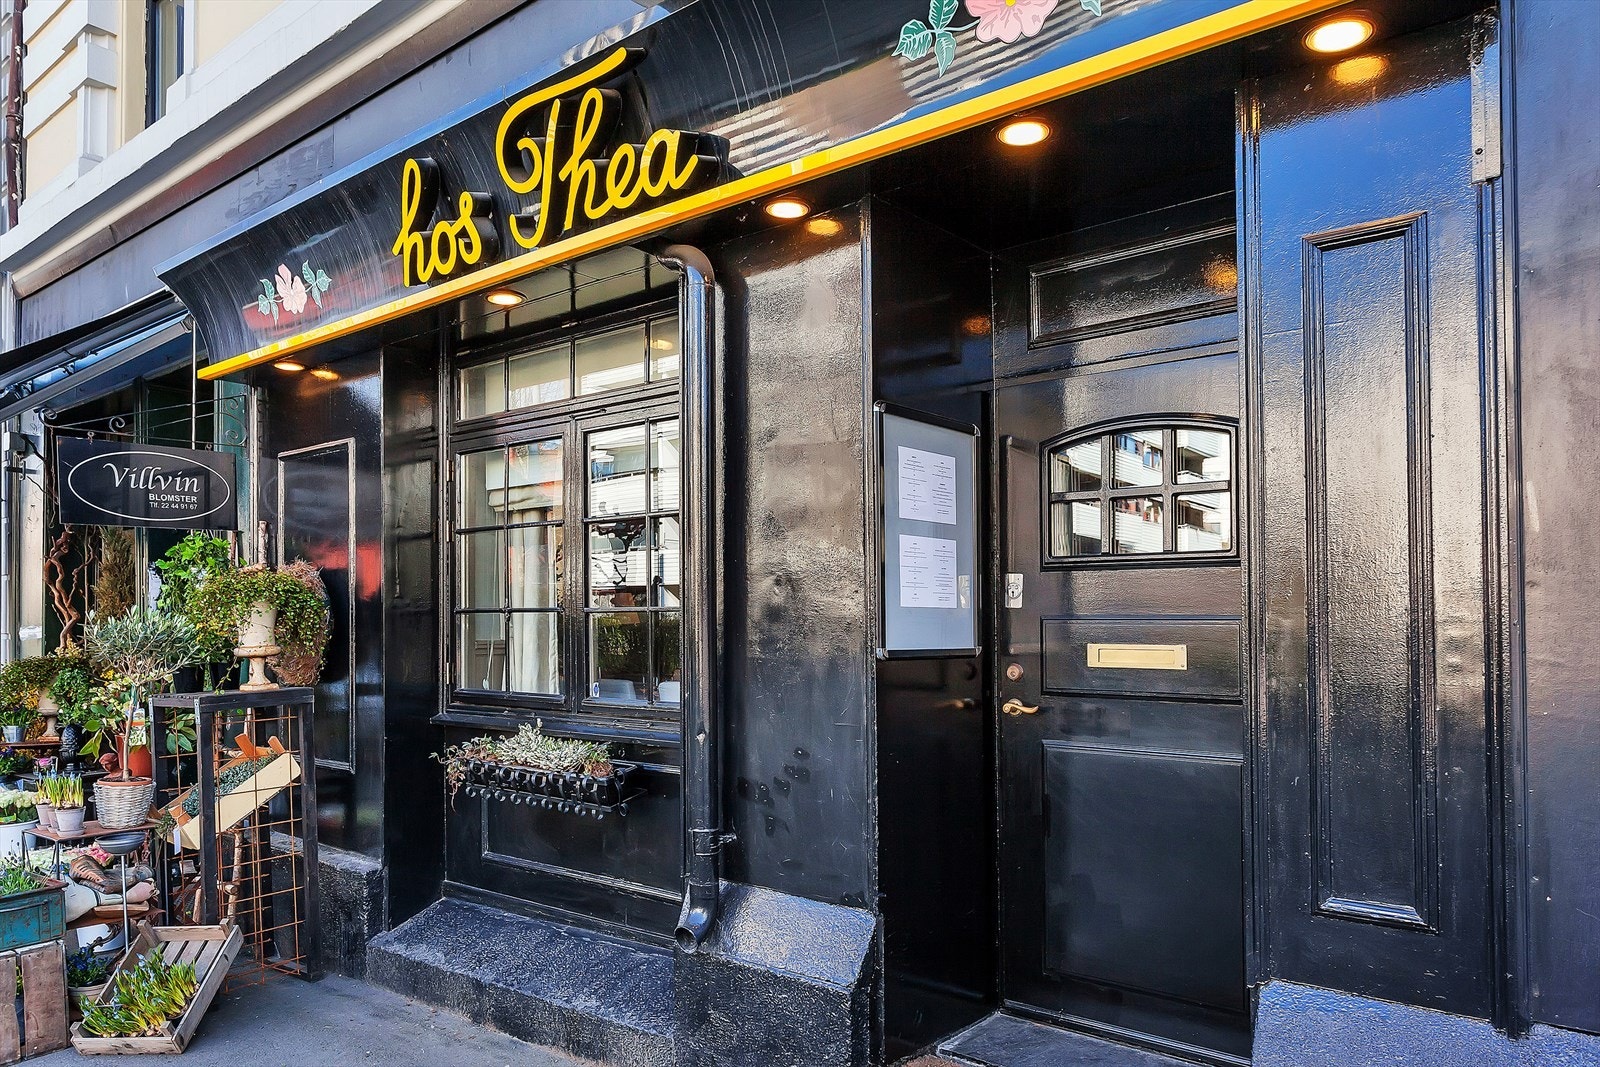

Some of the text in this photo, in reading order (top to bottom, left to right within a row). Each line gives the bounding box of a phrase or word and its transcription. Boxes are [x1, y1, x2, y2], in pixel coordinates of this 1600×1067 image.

[393, 46, 698, 287] hos Thea
[102, 463, 201, 493] Villvin
[148, 493, 198, 503] BLOMSTER
